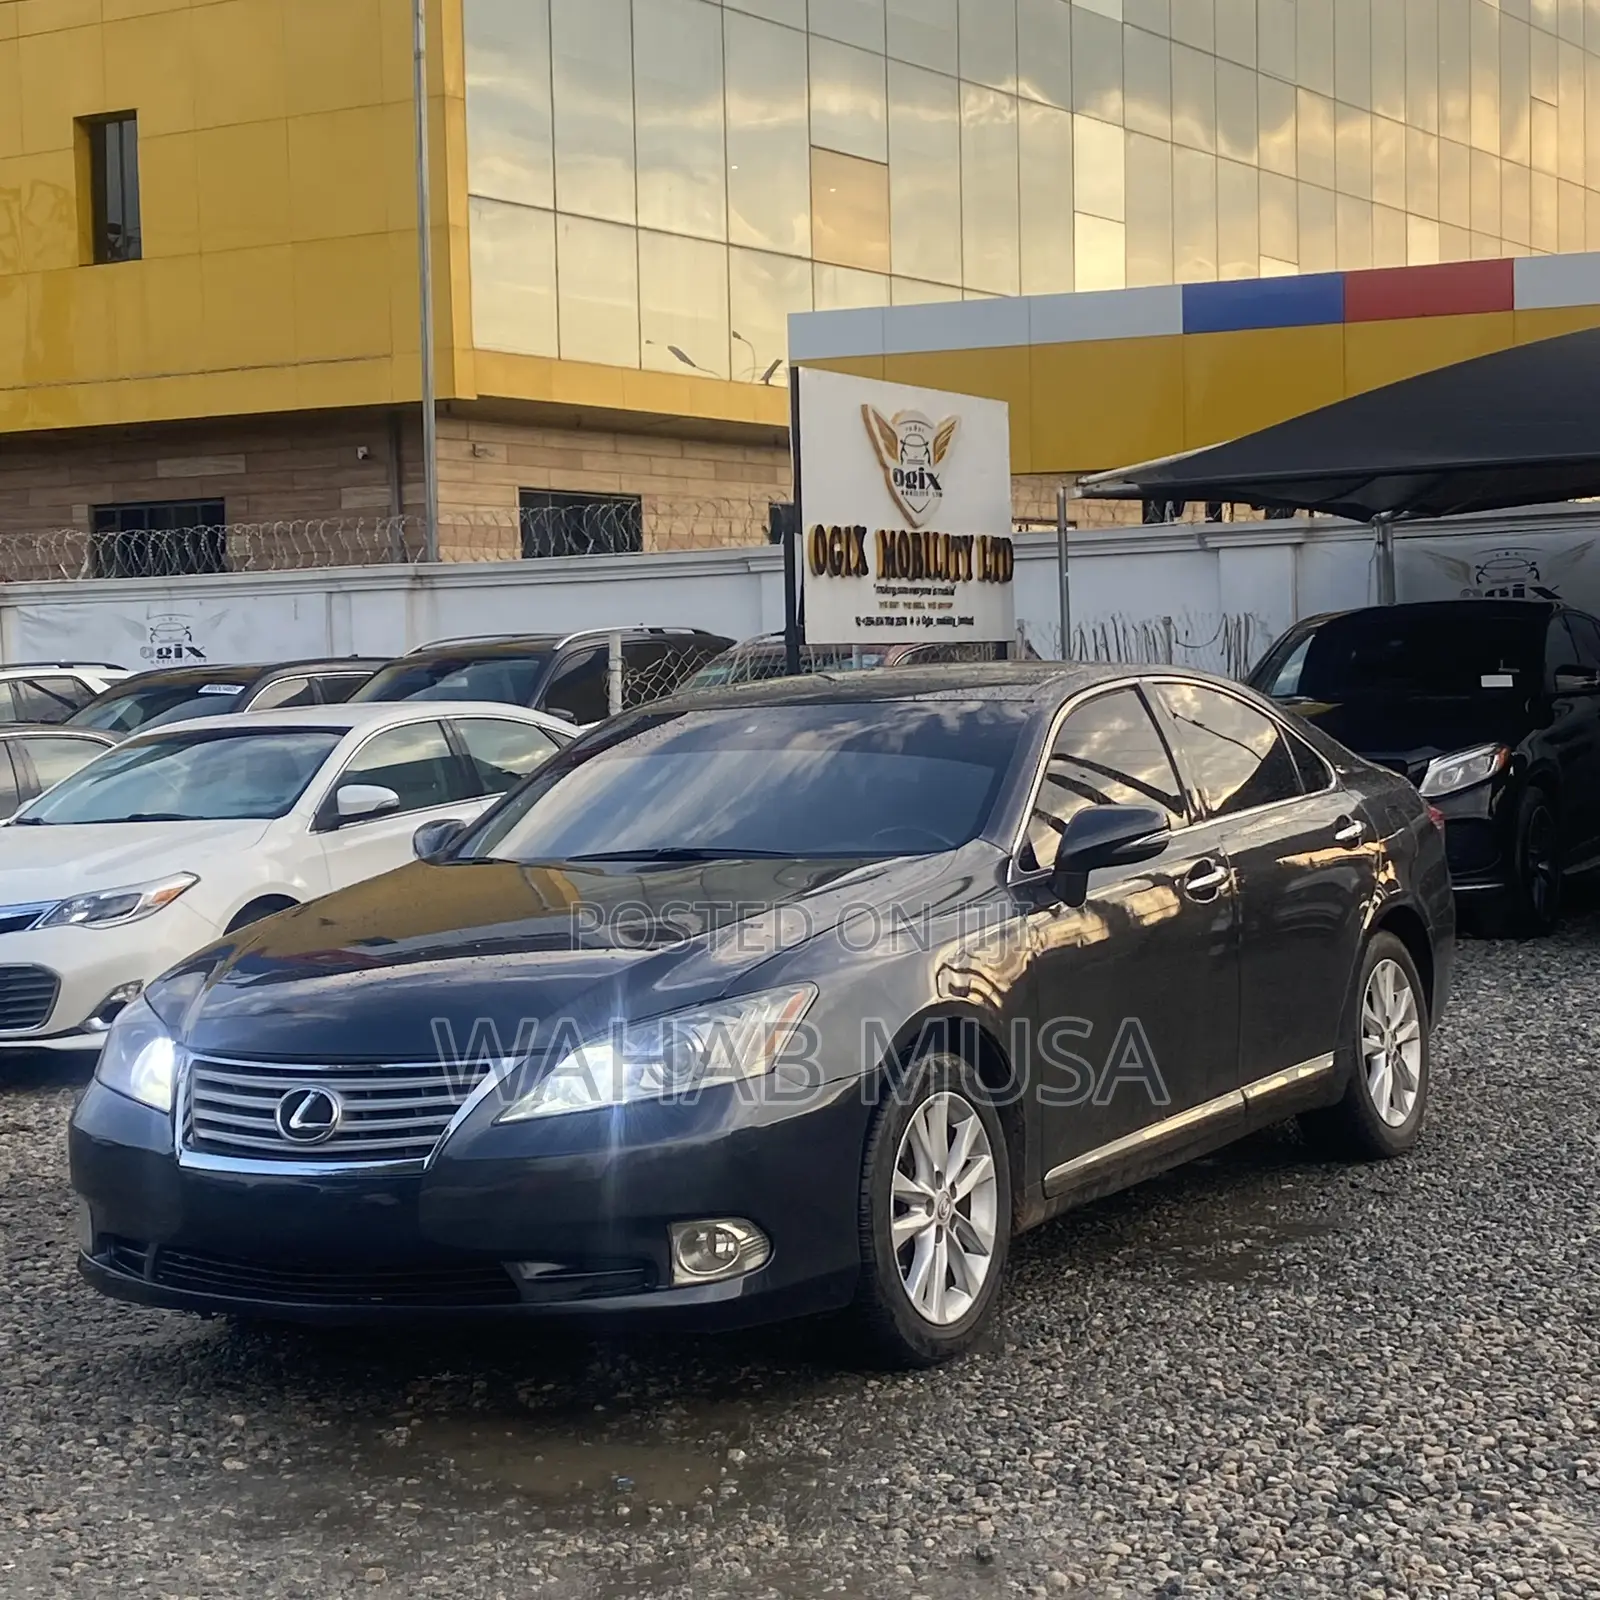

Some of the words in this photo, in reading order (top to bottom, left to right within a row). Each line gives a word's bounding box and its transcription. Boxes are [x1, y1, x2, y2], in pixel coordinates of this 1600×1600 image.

[808, 524, 869, 577] OGIX
[875, 529, 973, 583] MOBILITY
[976, 534, 1014, 583] LTD
